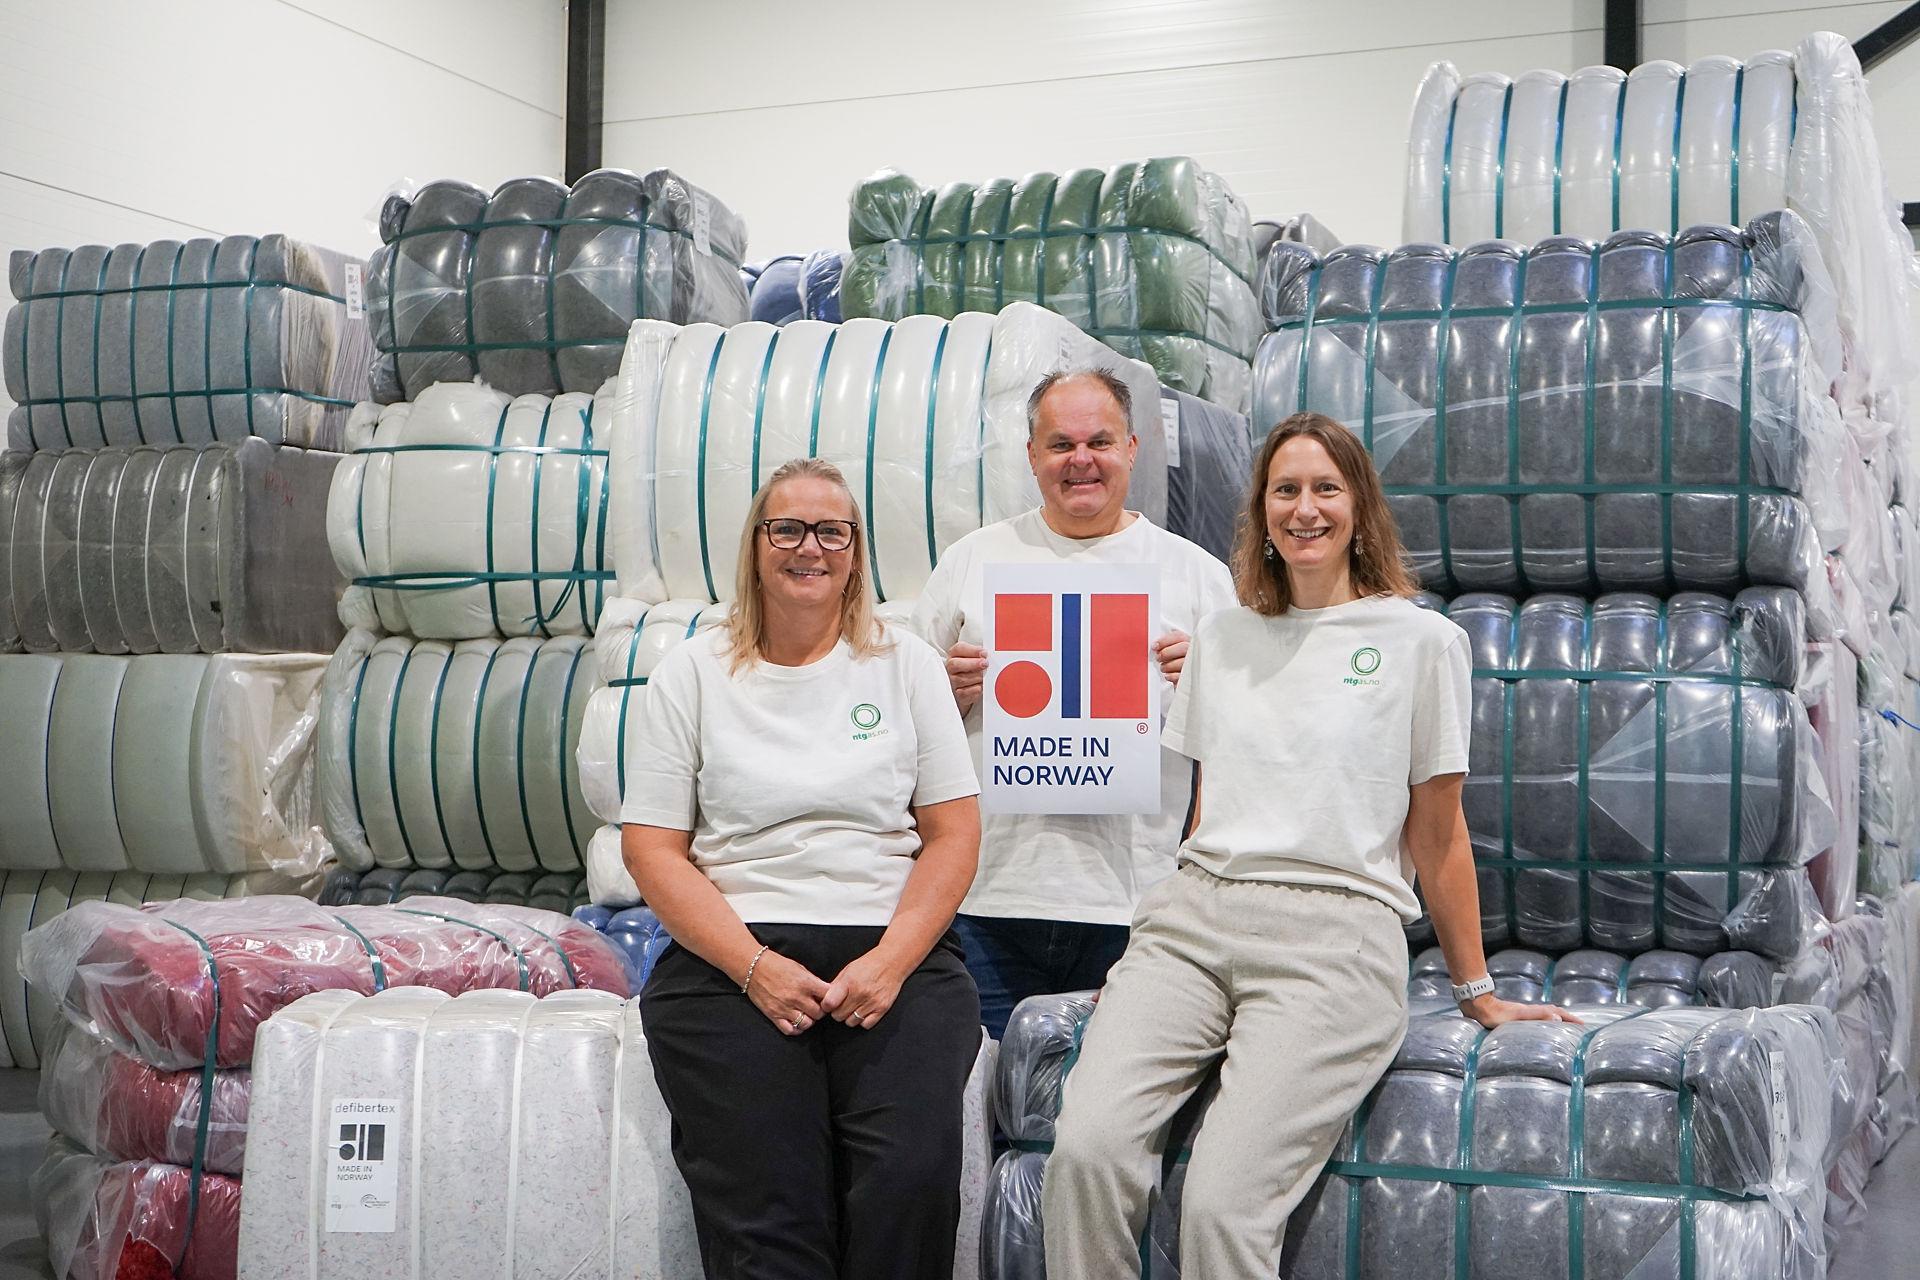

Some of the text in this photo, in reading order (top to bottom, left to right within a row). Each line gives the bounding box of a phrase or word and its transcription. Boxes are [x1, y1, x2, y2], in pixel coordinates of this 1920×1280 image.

[993, 736, 1110, 757] MADE IN
[993, 765, 1114, 786] NORWAY
[335, 1102, 396, 1113] defibertex
[337, 1165, 373, 1173] MADE IN
[336, 1173, 374, 1181] NORWAY
